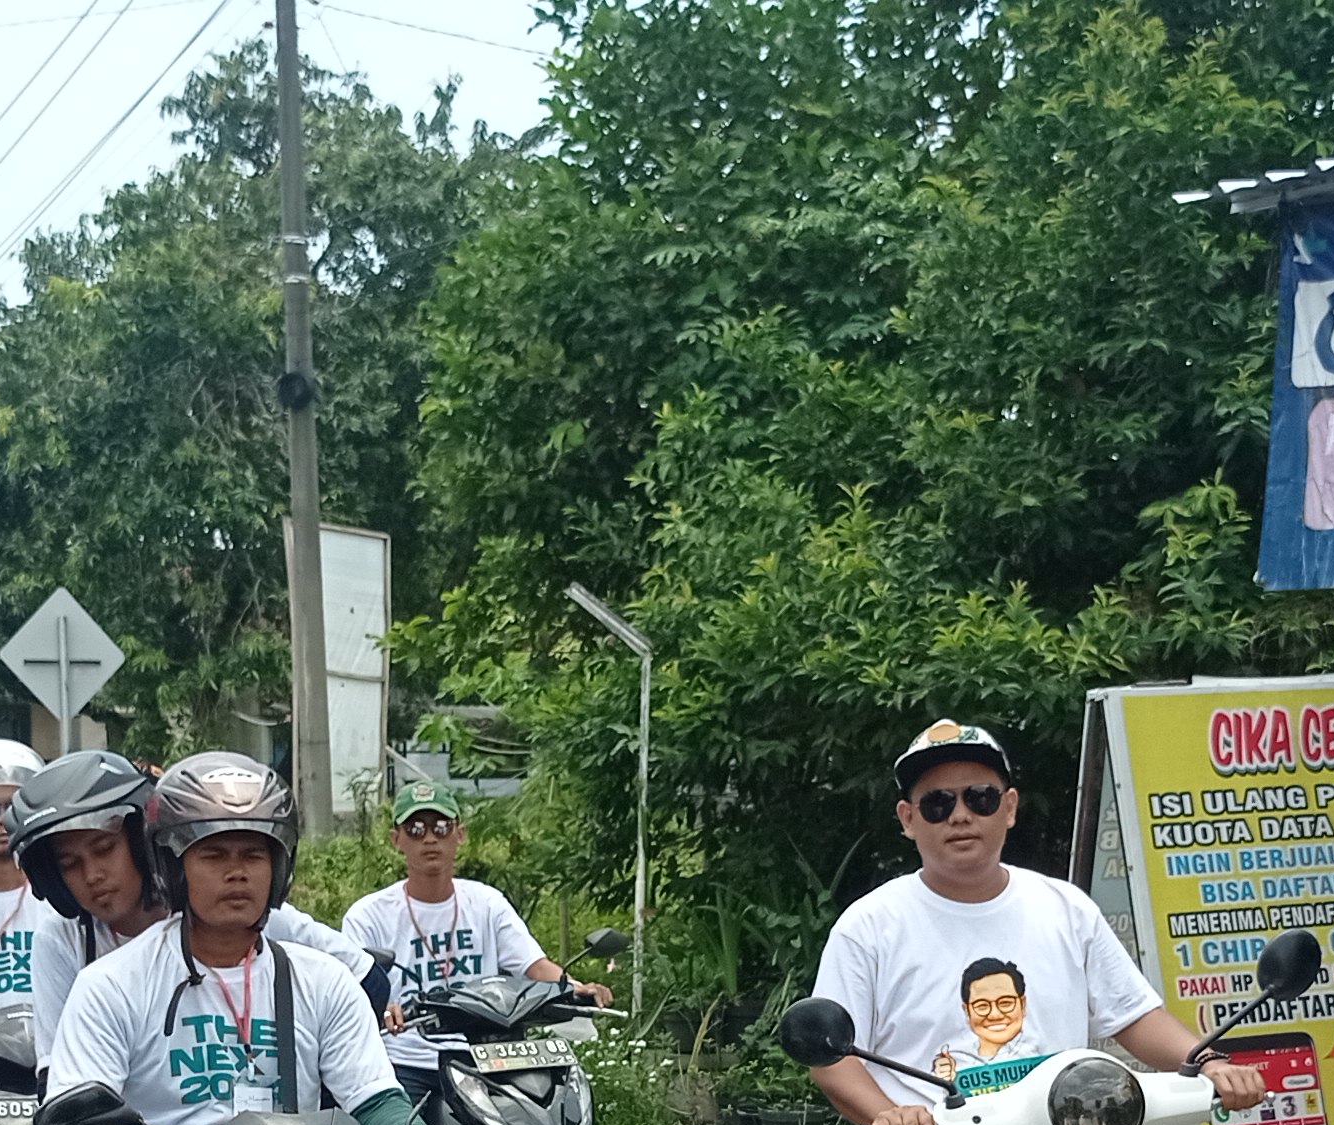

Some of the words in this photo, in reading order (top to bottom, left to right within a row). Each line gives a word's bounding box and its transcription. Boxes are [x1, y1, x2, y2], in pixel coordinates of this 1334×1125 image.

[1210, 709, 1295, 774] CIKA
[1149, 792, 1193, 818] ISI
[1202, 785, 1307, 814] ULANG
[1151, 820, 1253, 848] KUOTA
[1261, 813, 1334, 842] DATA
[1166, 851, 1232, 877] INGIN
[1200, 879, 1255, 905] BISA
[1169, 910, 1266, 938] MENERIMA
[410, 929, 475, 959] THE
[1176, 943, 1191, 967] 1
[1201, 938, 1267, 965] CHIP
[401, 954, 483, 986] NEXT
[1178, 976, 1227, 998] PAKAI
[1231, 973, 1254, 992] HP
[181, 1014, 279, 1047] THE
[475, 1046, 488, 1059] G
[495, 1042, 538, 1057] 3433
[959, 1070, 992, 1089] GUS
